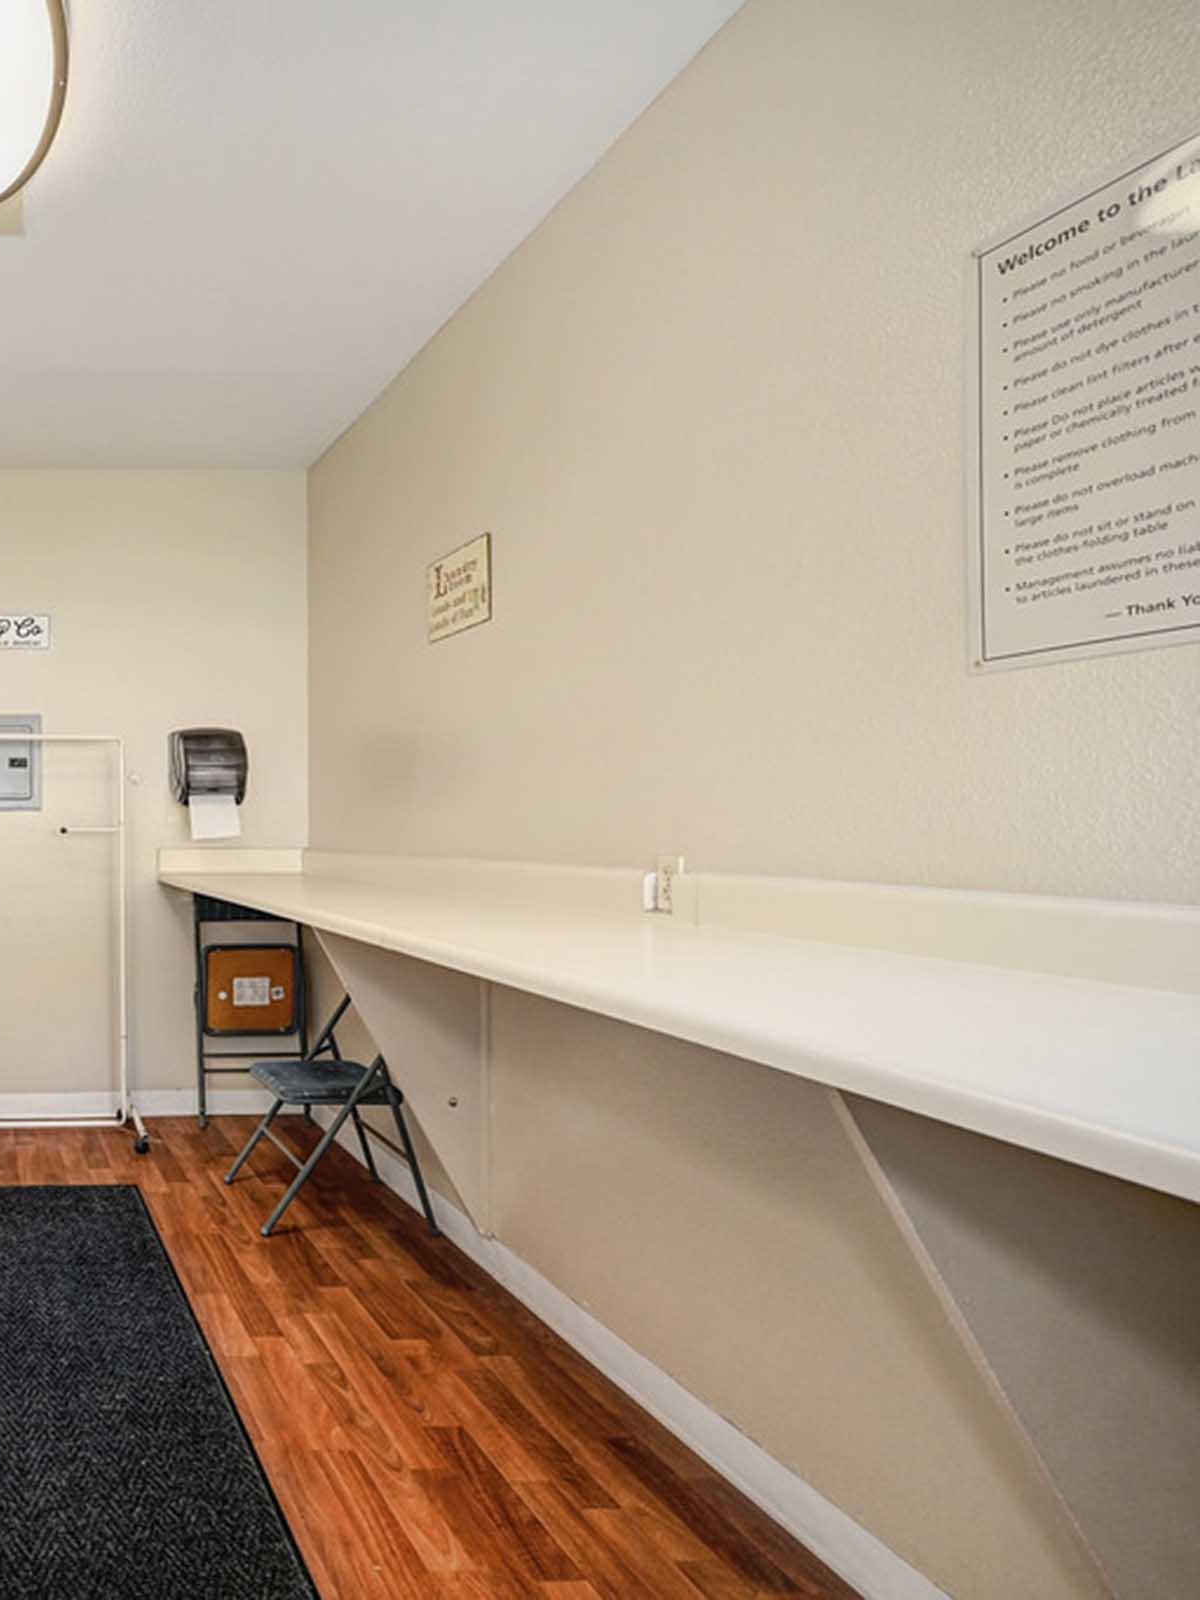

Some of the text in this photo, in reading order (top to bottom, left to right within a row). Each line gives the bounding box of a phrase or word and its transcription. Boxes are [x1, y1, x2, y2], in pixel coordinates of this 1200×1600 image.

[997, 219, 1089, 274] Welcome
[1096, 203, 1120, 222] to
[1127, 177, 1168, 206] the
[1012, 277, 1047, 299] Please
[1069, 249, 1099, 269] food
[1012, 303, 1047, 324] Please
[1050, 293, 1066, 306] no
[1069, 267, 1123, 297] smoking
[1126, 259, 1139, 270] in
[1143, 245, 1167, 262] the
[1012, 329, 1047, 349] Please
[1050, 318, 1070, 333] use
[1073, 305, 1100, 322] only
[1013, 299, 1141, 362] amount of detergent
[1013, 368, 1048, 387] Please
[1051, 360, 1067, 372] do
[1069, 348, 1091, 363] not
[1094, 339, 1118, 354] dye
[1121, 317, 1170, 342] clothes
[1013, 394, 1048, 412] Please
[1050, 380, 1083, 398] clean
[1086, 369, 1106, 384] lint
[1111, 354, 1150, 374] filters
[1154, 338, 1188, 359] after
[1013, 420, 1048, 438] Please
[1051, 412, 1069, 425] Do
[1071, 402, 1093, 416] not
[1097, 389, 1131, 409] place
[1135, 370, 1184, 394] articles
[1013, 434, 1046, 453] paper
[1049, 428, 1062, 439] or
[1065, 405, 1130, 432] chemically
[1135, 381, 1187, 408] treated
[1013, 410, 1196, 476] Please remove clothing from
[1013, 463, 1079, 489] is complete
[1014, 499, 1049, 514] Please
[1051, 493, 1068, 503] do
[1071, 484, 1093, 497] not
[1096, 465, 1155, 490] overload
[1014, 503, 1079, 527] large items
[1014, 499, 1196, 552] Please do not sit or stand on
[1014, 555, 1033, 566] the
[1132, 521, 1168, 536] table
[1015, 566, 1093, 590] Management
[1097, 554, 1151, 573] assumes
[1154, 549, 1174, 560] no
[1015, 595, 1027, 603] to
[1031, 586, 1071, 601] articles
[1075, 569, 1141, 591] laundered
[1144, 567, 1158, 576] in
[13, 616, 42, 637] Co
[1125, 597, 1175, 616] Thank
